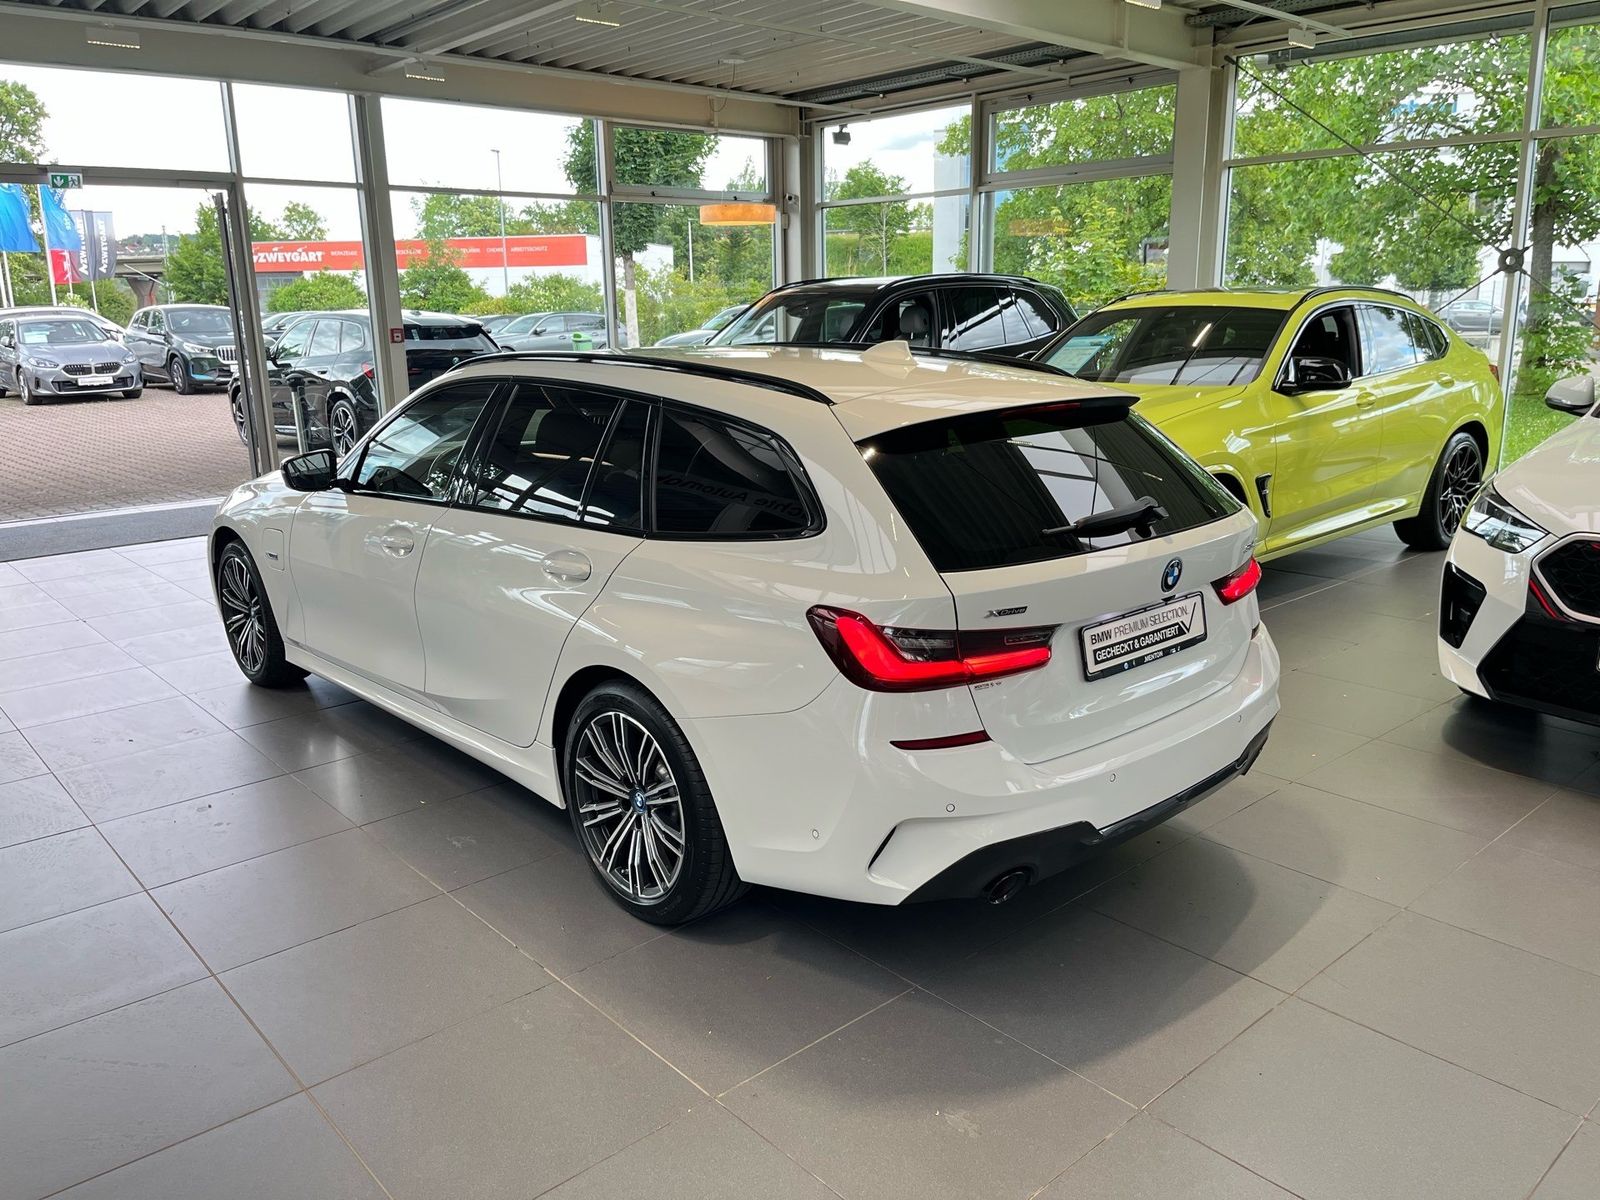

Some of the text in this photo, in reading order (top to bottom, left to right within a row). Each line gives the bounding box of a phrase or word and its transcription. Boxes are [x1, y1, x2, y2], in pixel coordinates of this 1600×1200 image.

[257, 251, 323, 263] ZWEYGART
[1090, 605, 1188, 645] BMW PREMIUM SELECTION
[1096, 625, 1180, 661] GECHECKT & GARANTIERT
